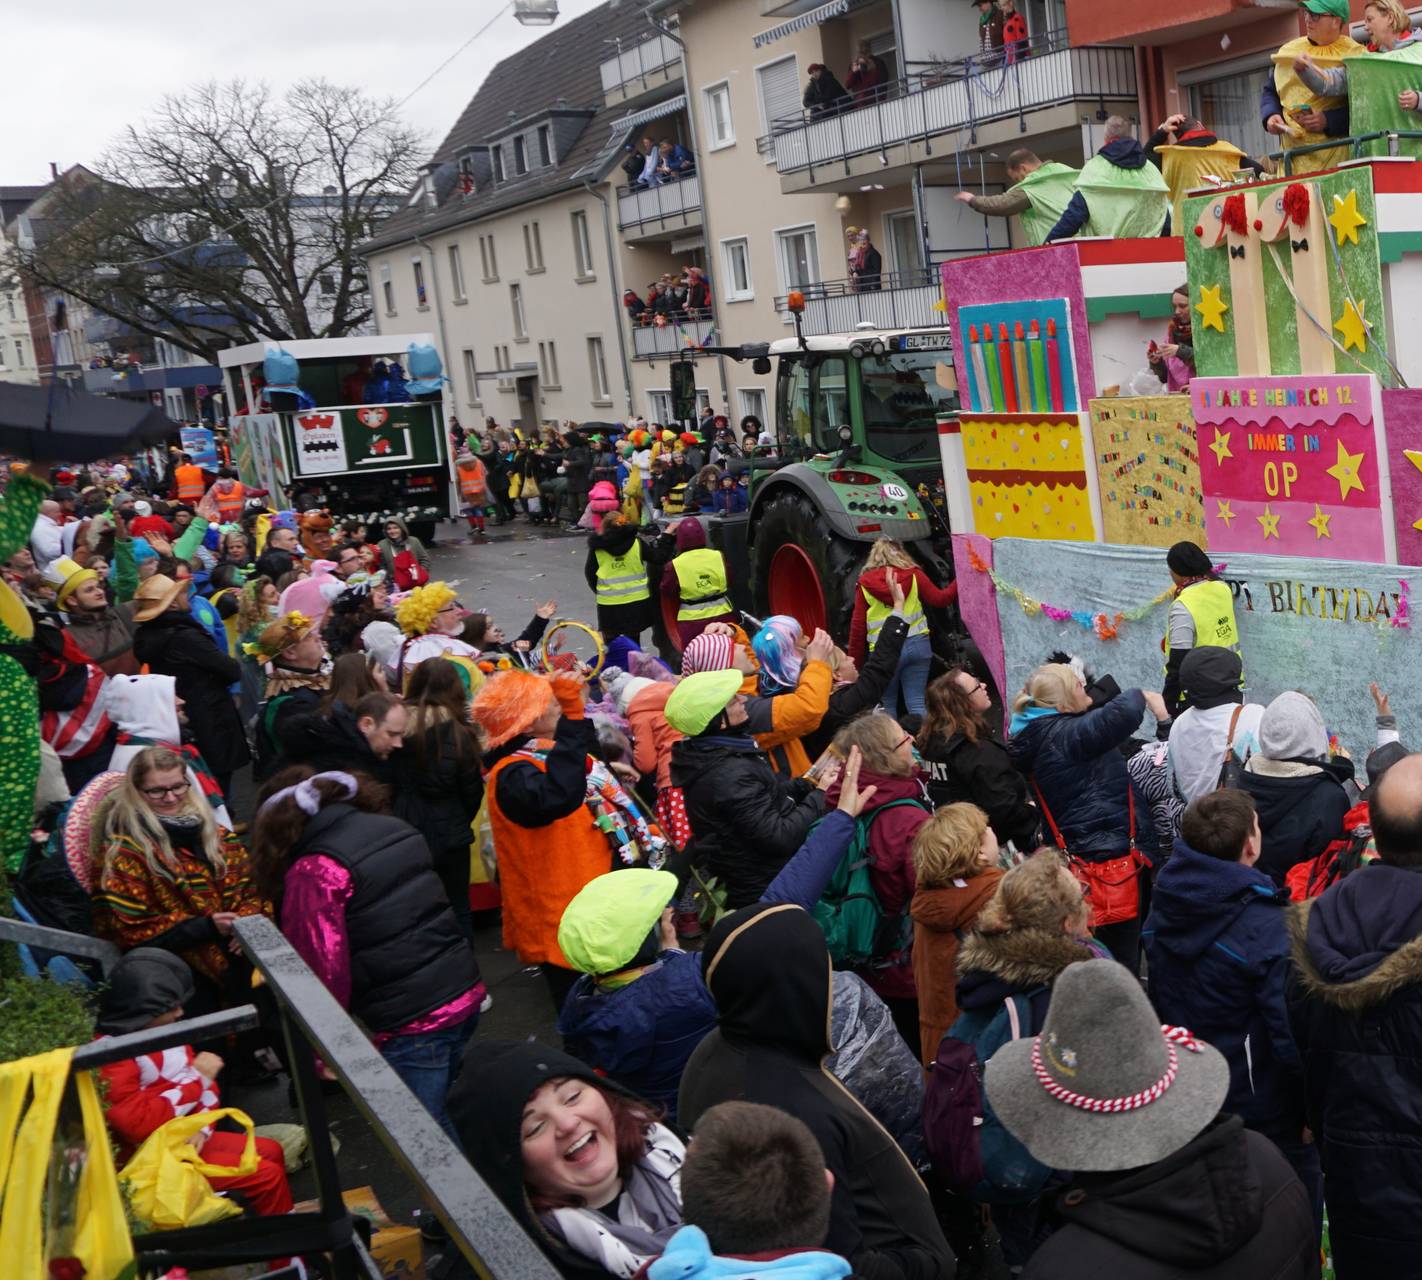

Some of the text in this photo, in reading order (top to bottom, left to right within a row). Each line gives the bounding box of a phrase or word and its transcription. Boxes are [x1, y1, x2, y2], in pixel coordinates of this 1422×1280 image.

[906, 337, 919, 348] GL
[927, 335, 938, 347] TW
[1216, 388, 1258, 408] JAHRE
[1264, 386, 1328, 408] HEINRICH
[1336, 385, 1358, 405] 12.
[1248, 433, 1320, 453] IMMER IN
[1264, 461, 1298, 498] OP
[888, 485, 904, 498] 40
